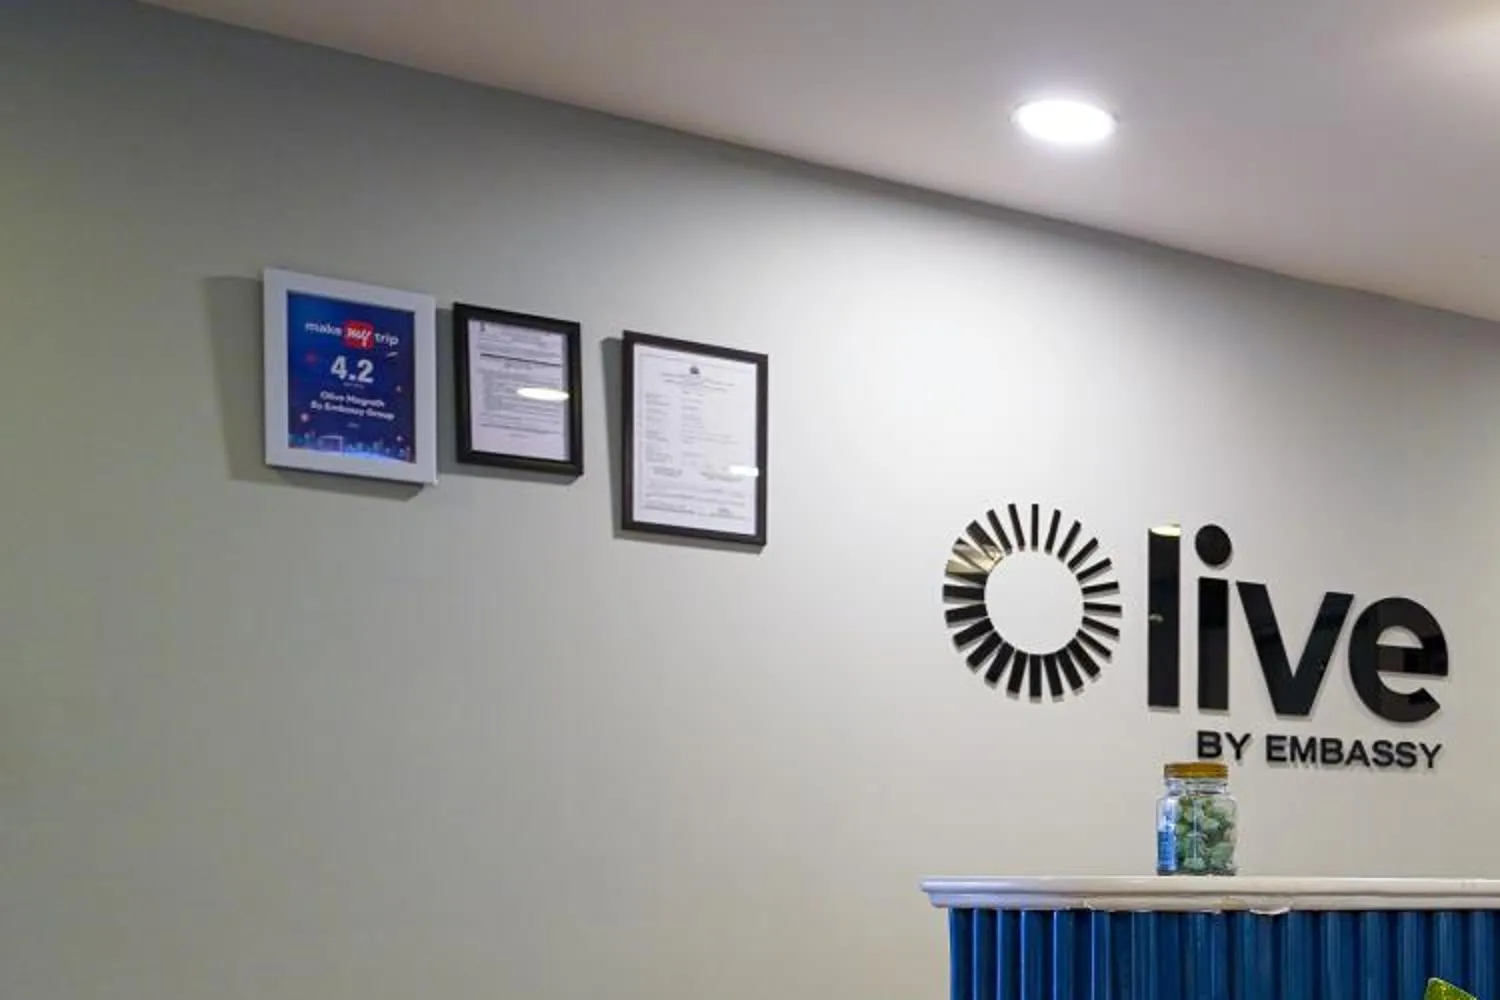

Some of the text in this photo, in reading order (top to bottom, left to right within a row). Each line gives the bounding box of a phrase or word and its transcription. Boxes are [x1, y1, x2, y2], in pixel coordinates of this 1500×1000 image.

[305, 322, 343, 336] make
[374, 332, 399, 347] trip
[330, 354, 375, 384] 4.2
[1197, 730, 1443, 770] BY EMBASSY
